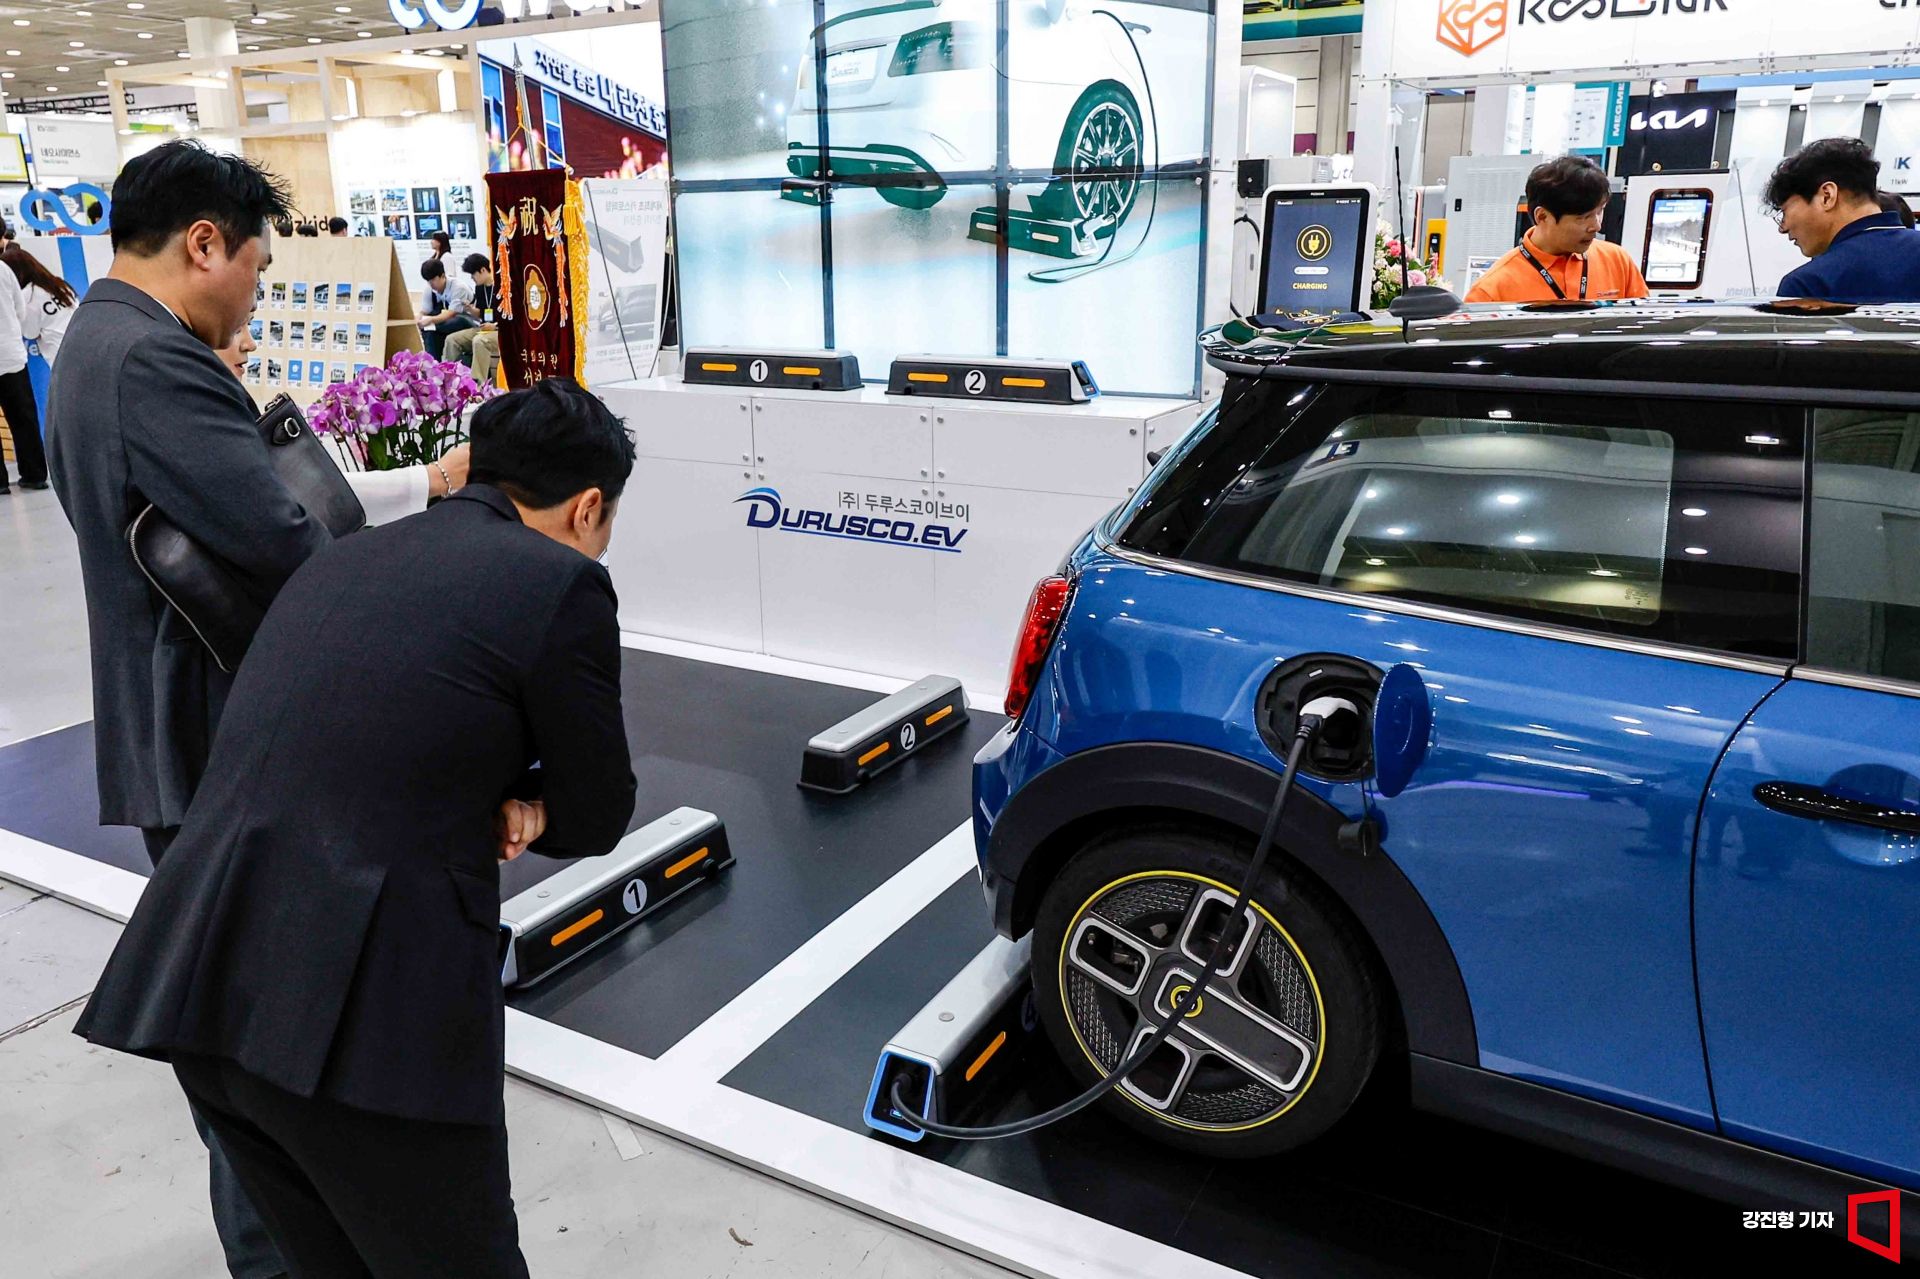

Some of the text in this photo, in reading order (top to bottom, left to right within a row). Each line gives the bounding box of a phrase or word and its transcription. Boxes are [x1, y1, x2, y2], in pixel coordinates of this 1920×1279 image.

[519, 196, 539, 237] 祝
[1292, 282, 1329, 290] CHARGING
[864, 494, 970, 523] 두루스코이브이
